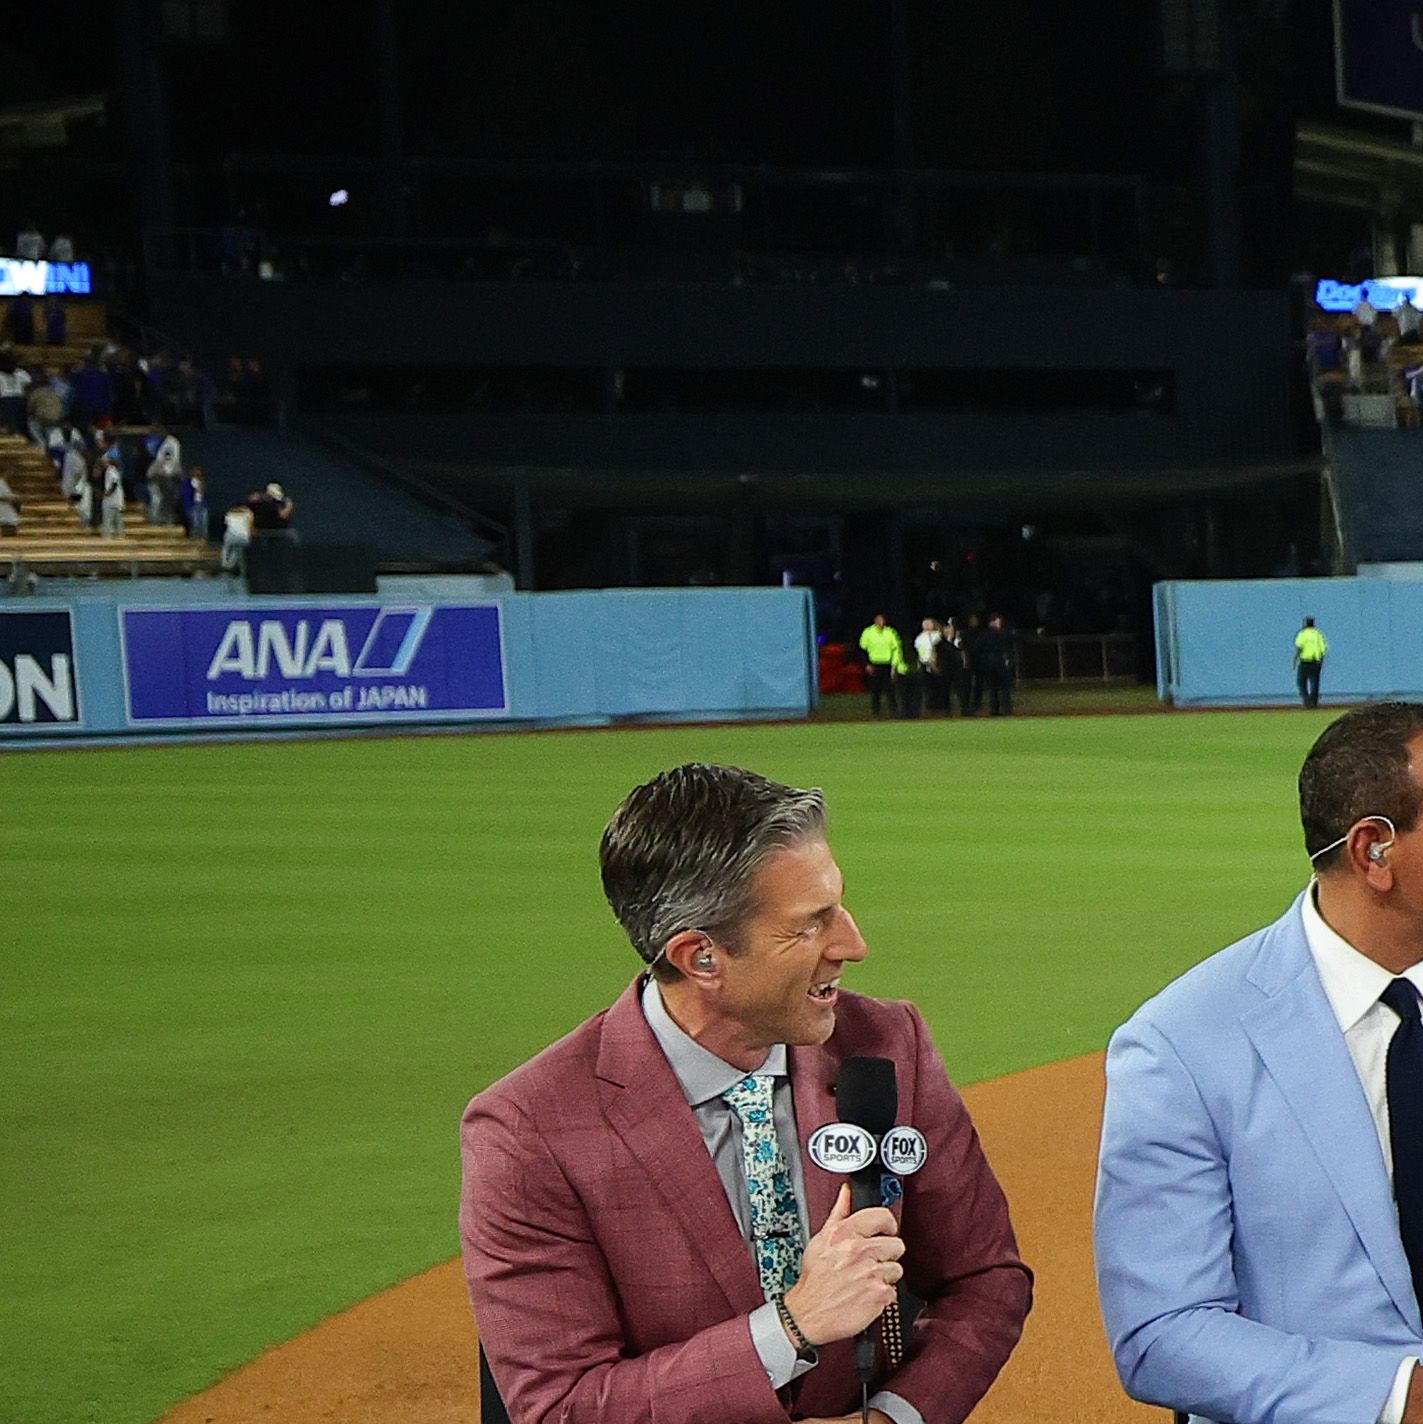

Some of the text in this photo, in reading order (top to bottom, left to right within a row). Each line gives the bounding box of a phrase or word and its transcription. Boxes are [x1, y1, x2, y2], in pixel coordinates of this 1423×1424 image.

[208, 620, 351, 679] ANA
[0, 654, 75, 722] N
[207, 685, 426, 714] Inspiration of JAPAN
[824, 1135, 860, 1154] FOX
[892, 1137, 917, 1156] FOX
[824, 1153, 861, 1162] SPORTS
[891, 1156, 917, 1164] SPORTS
